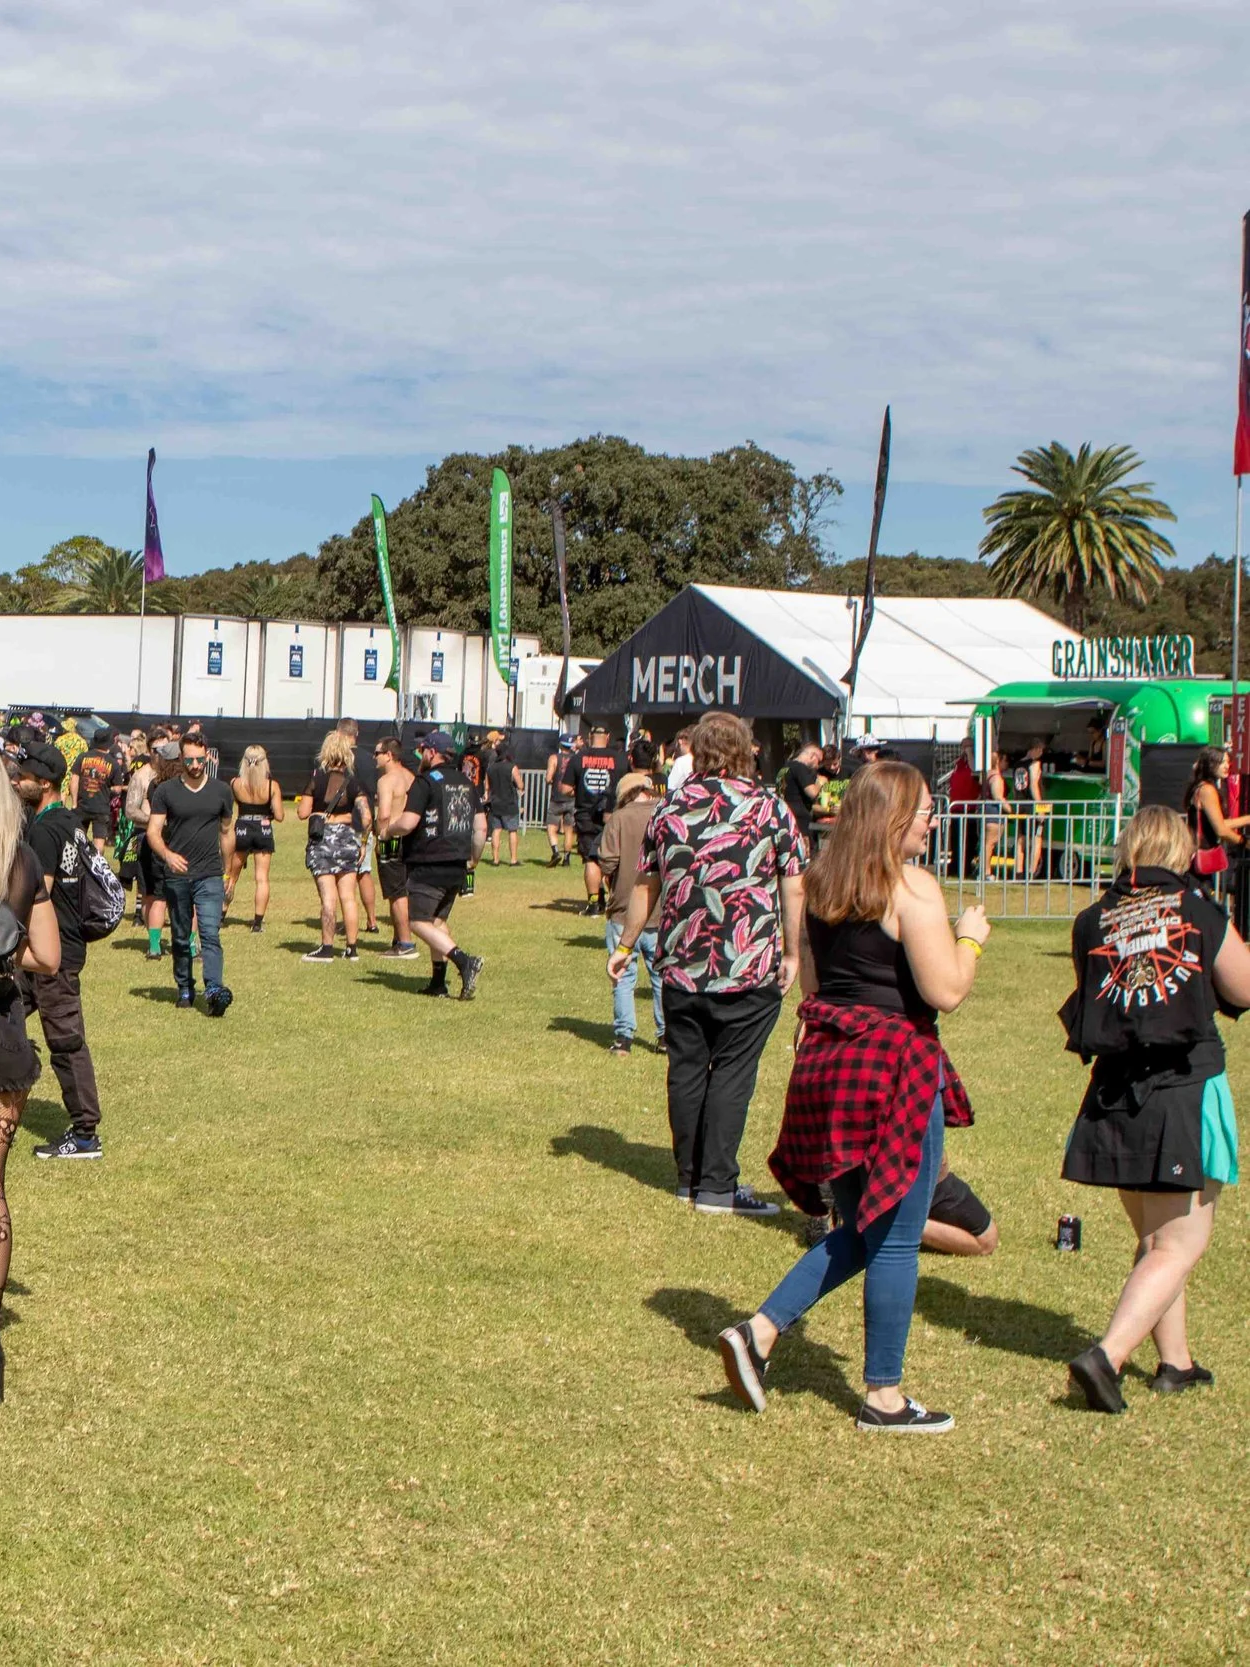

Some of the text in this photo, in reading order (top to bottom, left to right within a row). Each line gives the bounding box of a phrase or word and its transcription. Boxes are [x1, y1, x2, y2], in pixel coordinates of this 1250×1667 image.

[496, 633, 510, 669] EXIT
[1052, 634, 1195, 678] GRAINSHAKER
[631, 654, 742, 706] MERCH
[1236, 697, 1246, 770] EXIT
[1103, 915, 1182, 945] DISTURBED
[1115, 926, 1169, 962] PANTERA
[1100, 950, 1199, 1008] AUSTRALIA
